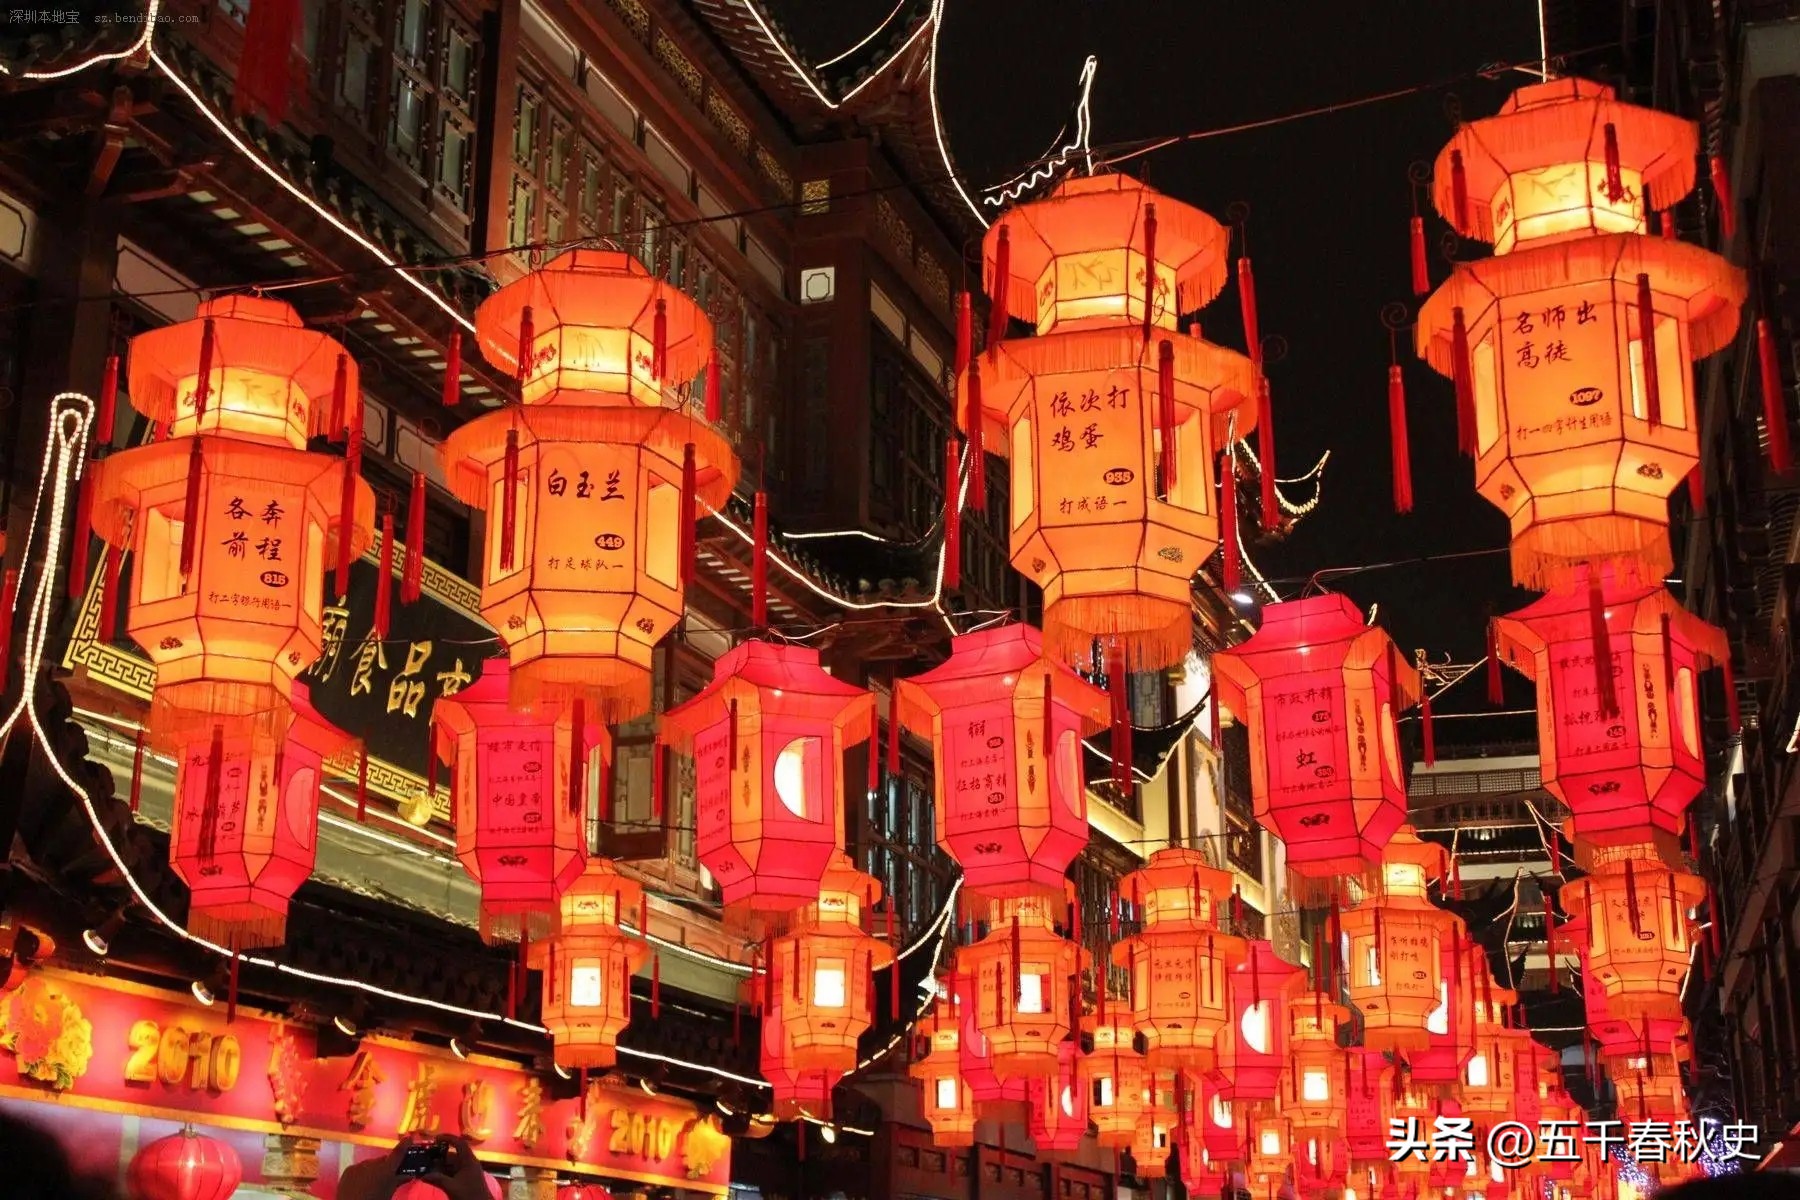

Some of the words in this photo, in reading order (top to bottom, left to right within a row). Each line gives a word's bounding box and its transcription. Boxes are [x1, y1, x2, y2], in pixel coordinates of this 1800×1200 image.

[1513, 300, 1597, 334] 名师出
[1516, 340, 1572, 369] 高徒
[1050, 385, 1130, 418] 依次打
[1051, 423, 1104, 452] 鸡蛋
[547, 468, 625, 501] 白玉兰
[224, 496, 286, 529] 各奔
[1059, 496, 1127, 514] 打成语一
[220, 531, 283, 562] 前程
[547, 556, 624, 570] 打足球队一
[1296, 748, 1317, 769] 虹
[125, 1020, 241, 1091] 2010
[608, 1108, 676, 1160] 2010
